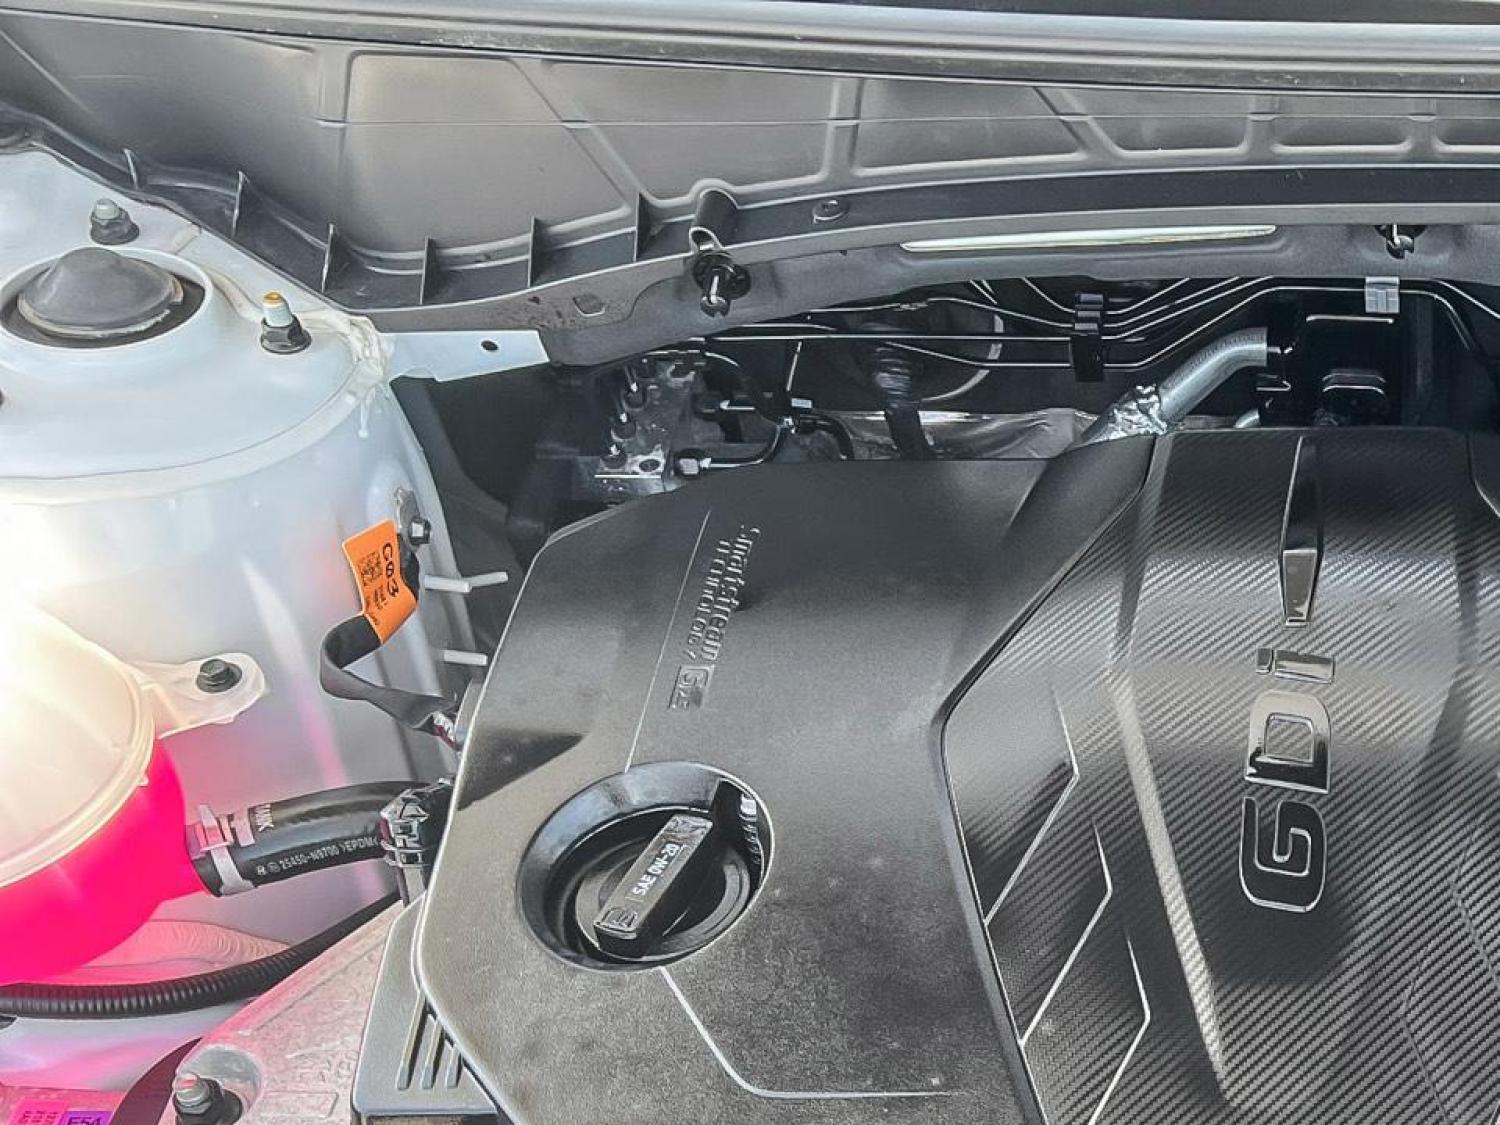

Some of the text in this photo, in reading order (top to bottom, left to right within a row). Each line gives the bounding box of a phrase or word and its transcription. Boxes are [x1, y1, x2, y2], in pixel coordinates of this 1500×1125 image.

[700, 526, 761, 661] Smartstream
[632, 843, 681, 896] SAE 0W-20
